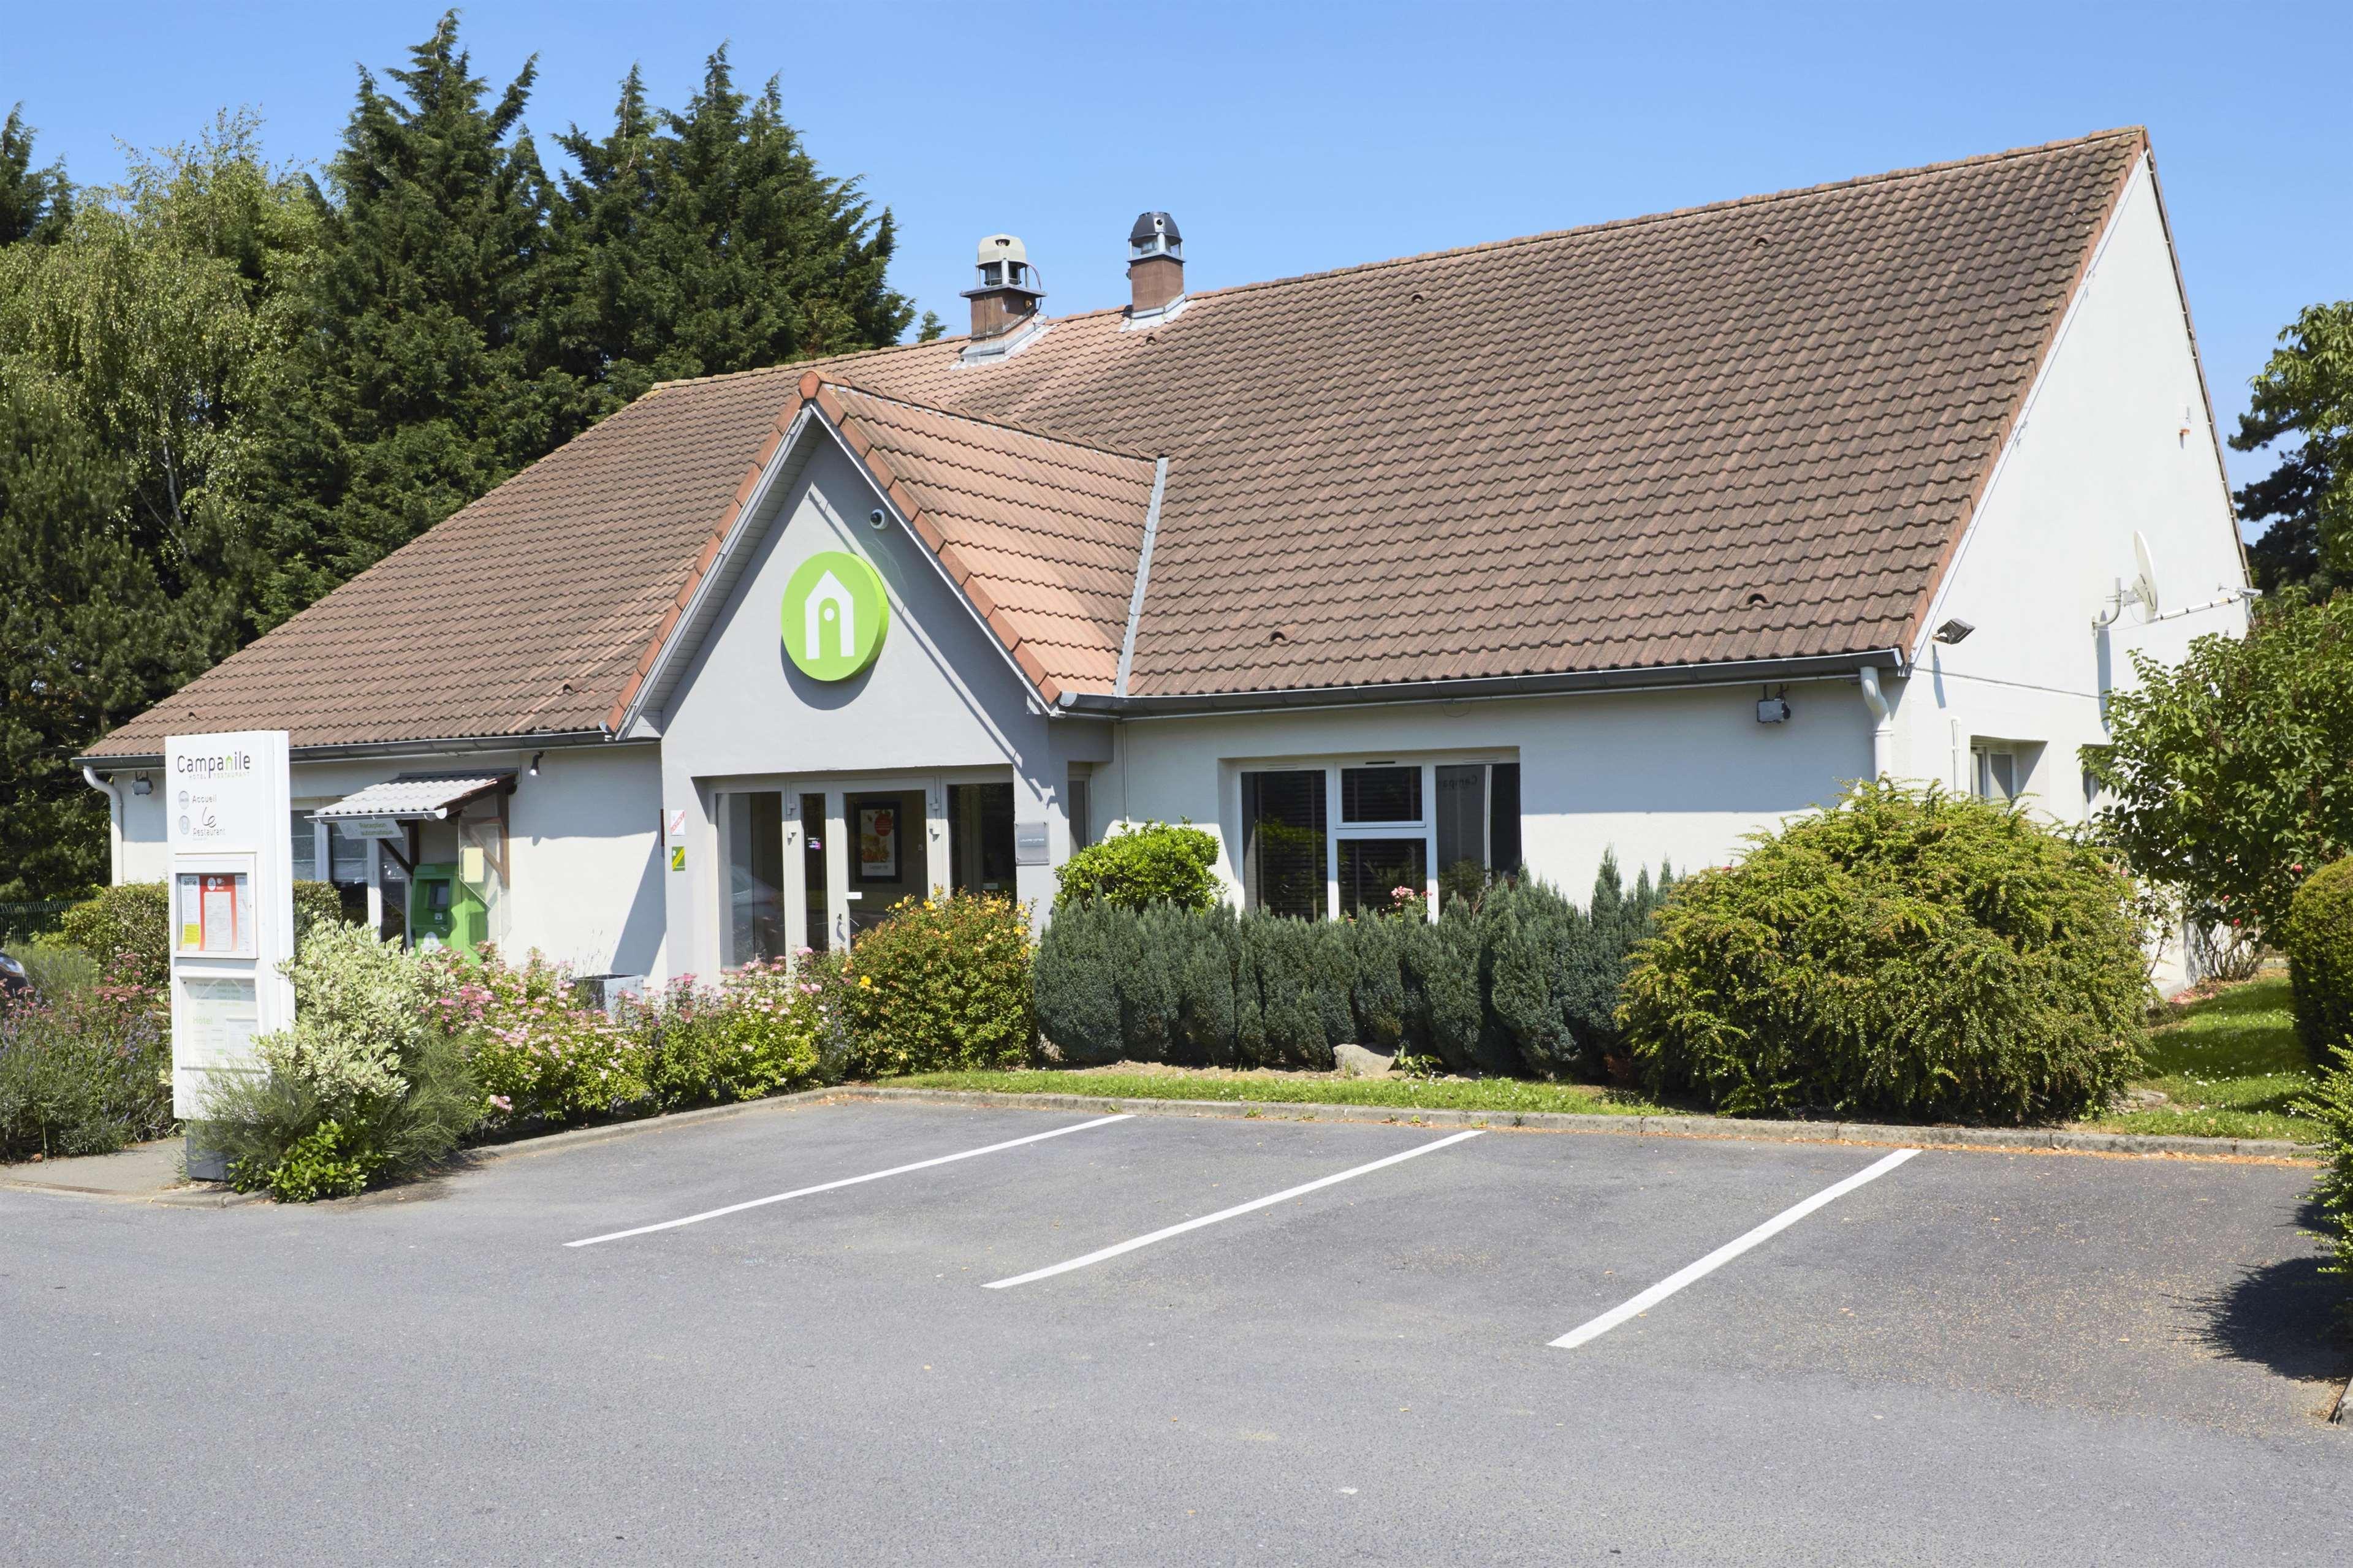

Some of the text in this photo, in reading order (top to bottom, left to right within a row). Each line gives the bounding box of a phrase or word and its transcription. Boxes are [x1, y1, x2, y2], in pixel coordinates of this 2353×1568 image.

[177, 751, 251, 779] Campanile
[192, 795, 216, 803] Accueil
[193, 828, 226, 837] Restaurant
